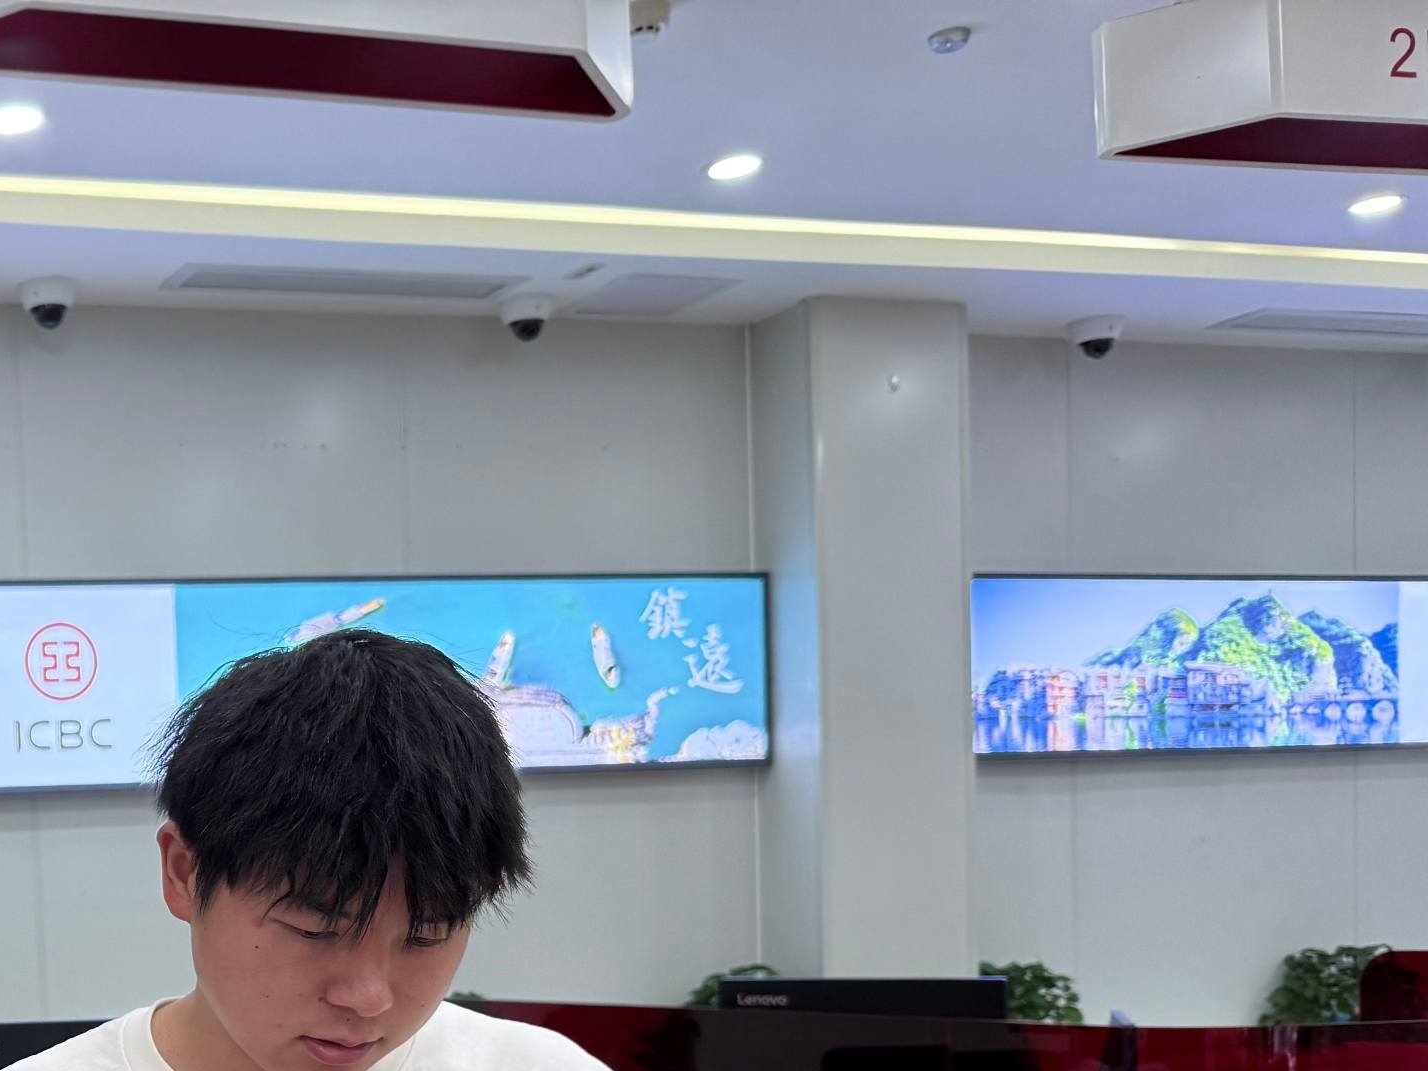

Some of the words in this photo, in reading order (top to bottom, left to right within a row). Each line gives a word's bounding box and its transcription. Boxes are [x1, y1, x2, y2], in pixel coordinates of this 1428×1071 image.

[1390, 27, 1417, 78] 2
[15, 718, 113, 752] ICBC
[736, 992, 788, 1007] Lenovo
